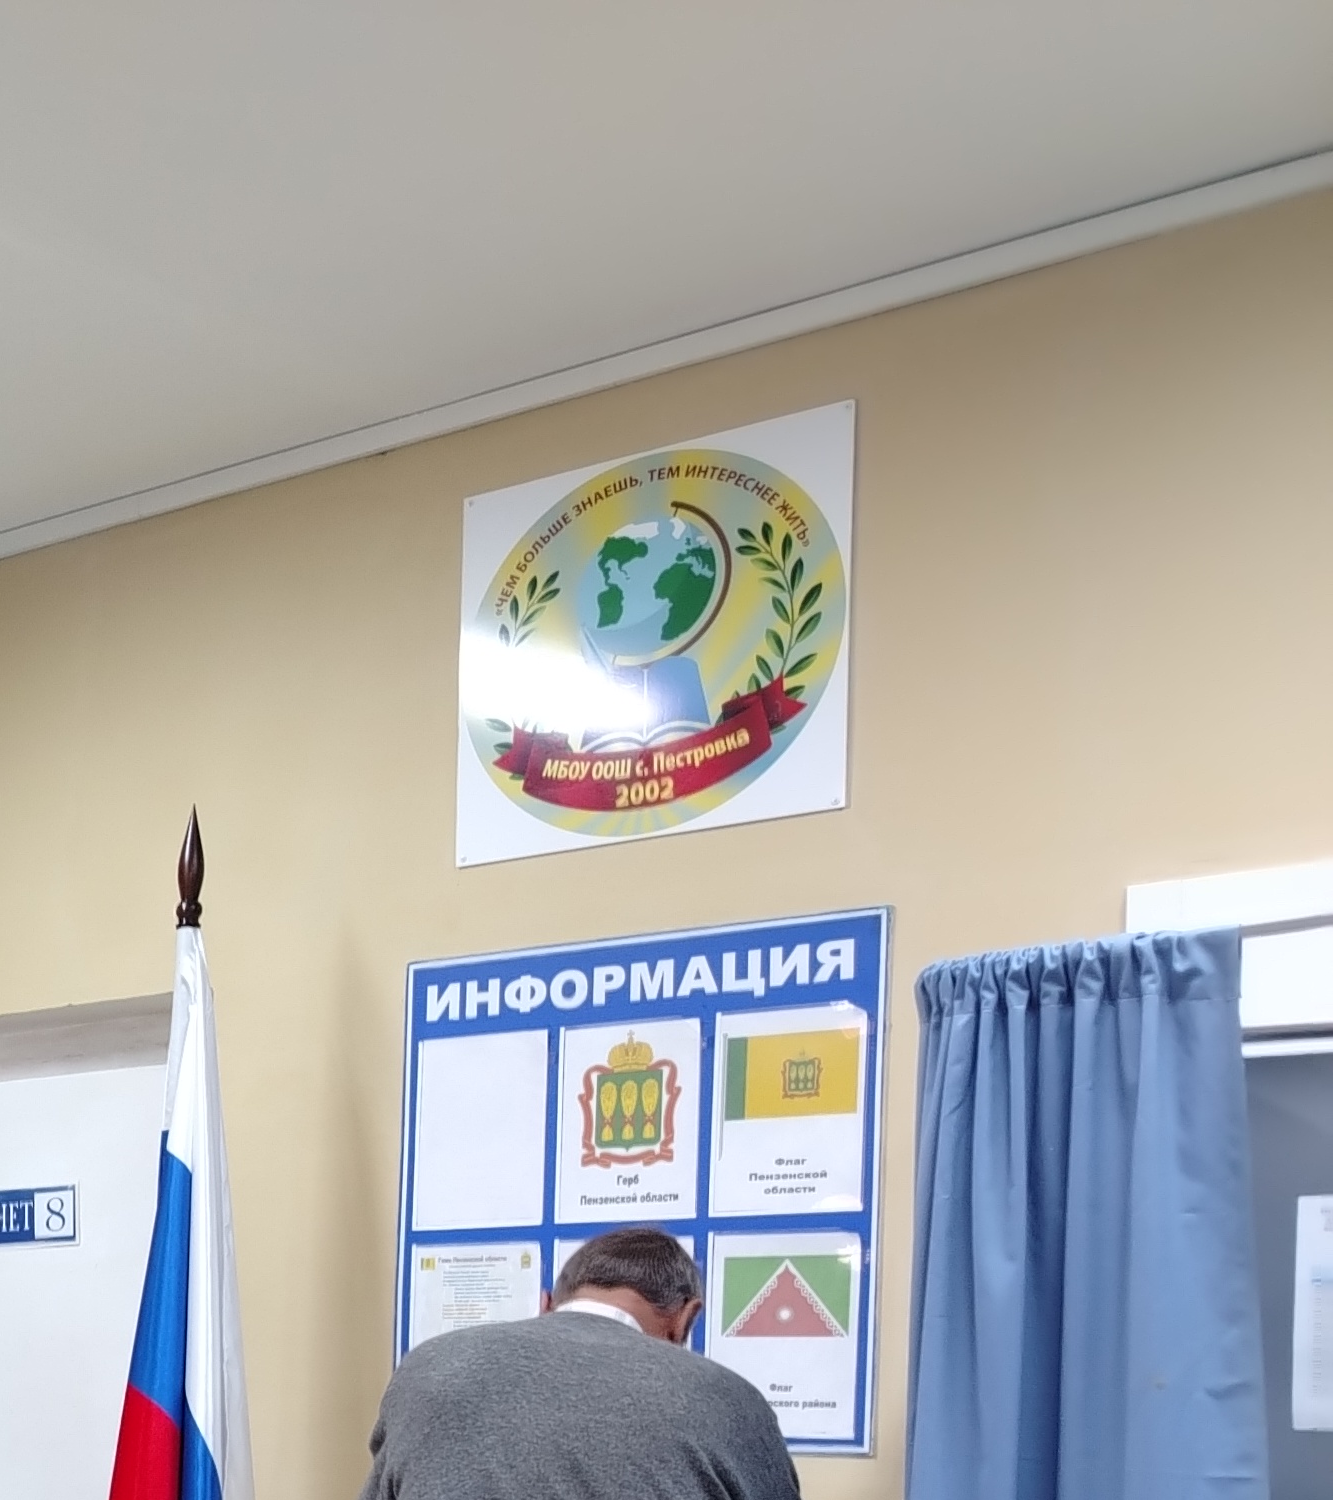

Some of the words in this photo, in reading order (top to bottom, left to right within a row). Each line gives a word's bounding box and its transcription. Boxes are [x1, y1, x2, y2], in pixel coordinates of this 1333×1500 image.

[515, 512, 572, 574] БОЛЬШЕ
[572, 475, 643, 517] ЗНАЕШЬ,
[648, 465, 680, 482] ТЕМ
[684, 464, 780, 507] ИНТЕРЕСНЕЕ
[542, 758, 590, 781] МБОУ
[592, 758, 631, 780] ООШ
[635, 762, 649, 777] с.
[653, 728, 750, 776] Пестровка
[614, 776, 675, 808] 2002
[425, 937, 856, 1023] ИНФОРМАЦИЯ
[774, 1158, 807, 1166] Флаг
[617, 1174, 639, 1188] Герб
[749, 1170, 827, 1181] Пензенской
[764, 1186, 816, 1194] области
[580, 1193, 637, 1206] Пензенской
[640, 1192, 679, 1203] области
[45, 1197, 66, 1232] 8
[769, 1383, 793, 1392] Флаг
[802, 1399, 837, 1410] района
